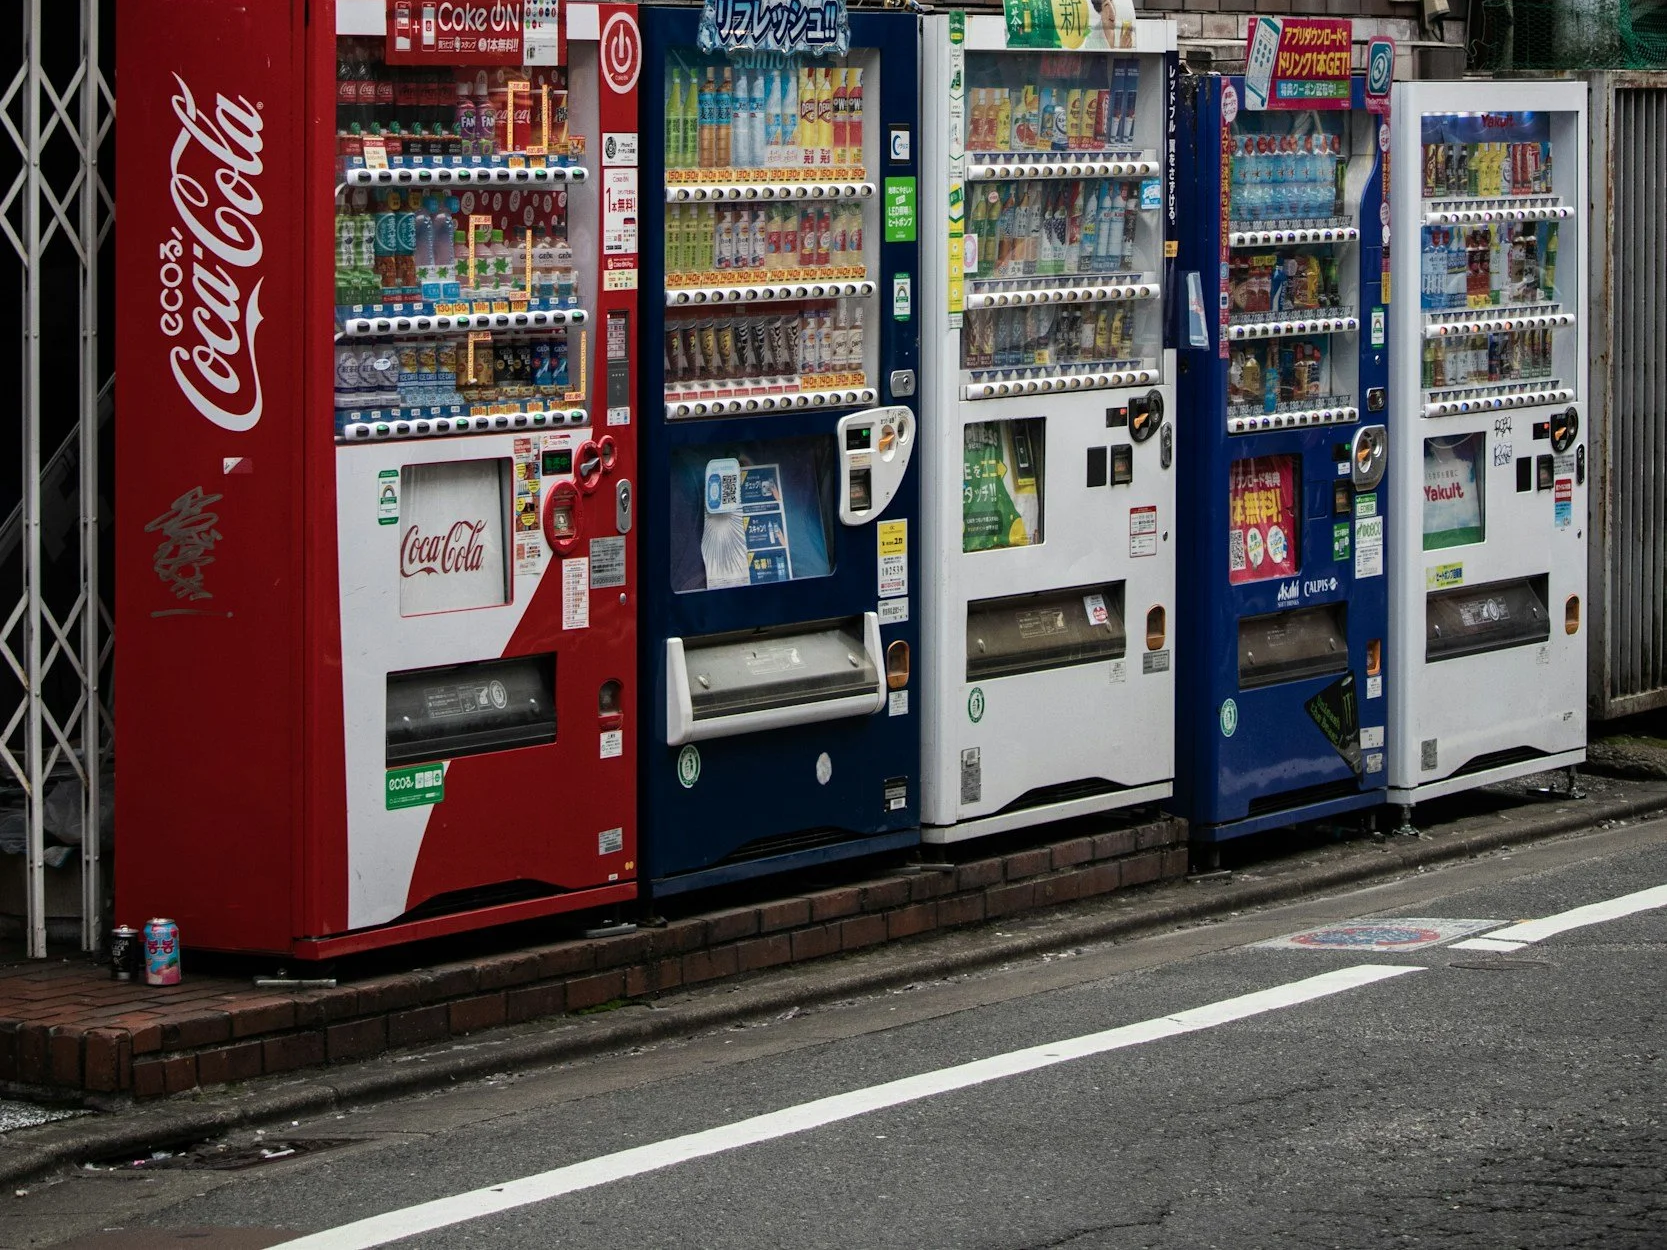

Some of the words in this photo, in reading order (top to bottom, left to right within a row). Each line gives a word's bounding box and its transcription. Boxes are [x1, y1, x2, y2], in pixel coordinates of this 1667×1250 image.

[438, 2, 487, 32] Coke
[1284, 26, 1348, 46] アプリダウンロードで
[1278, 51, 1350, 77] ドリンク1本GET!
[1168, 65, 1177, 133] レッドブル
[1481, 113, 1515, 128] Yakult
[606, 187, 636, 213] 1本無料!
[888, 217, 913, 228] ヒートポンプ
[170, 70, 265, 433] Coca-Cola
[1424, 481, 1464, 502] Yakult
[400, 519, 488, 578] Coca-Cola
[1278, 581, 1300, 601] Asahi
[1304, 579, 1329, 597] CALPIS
